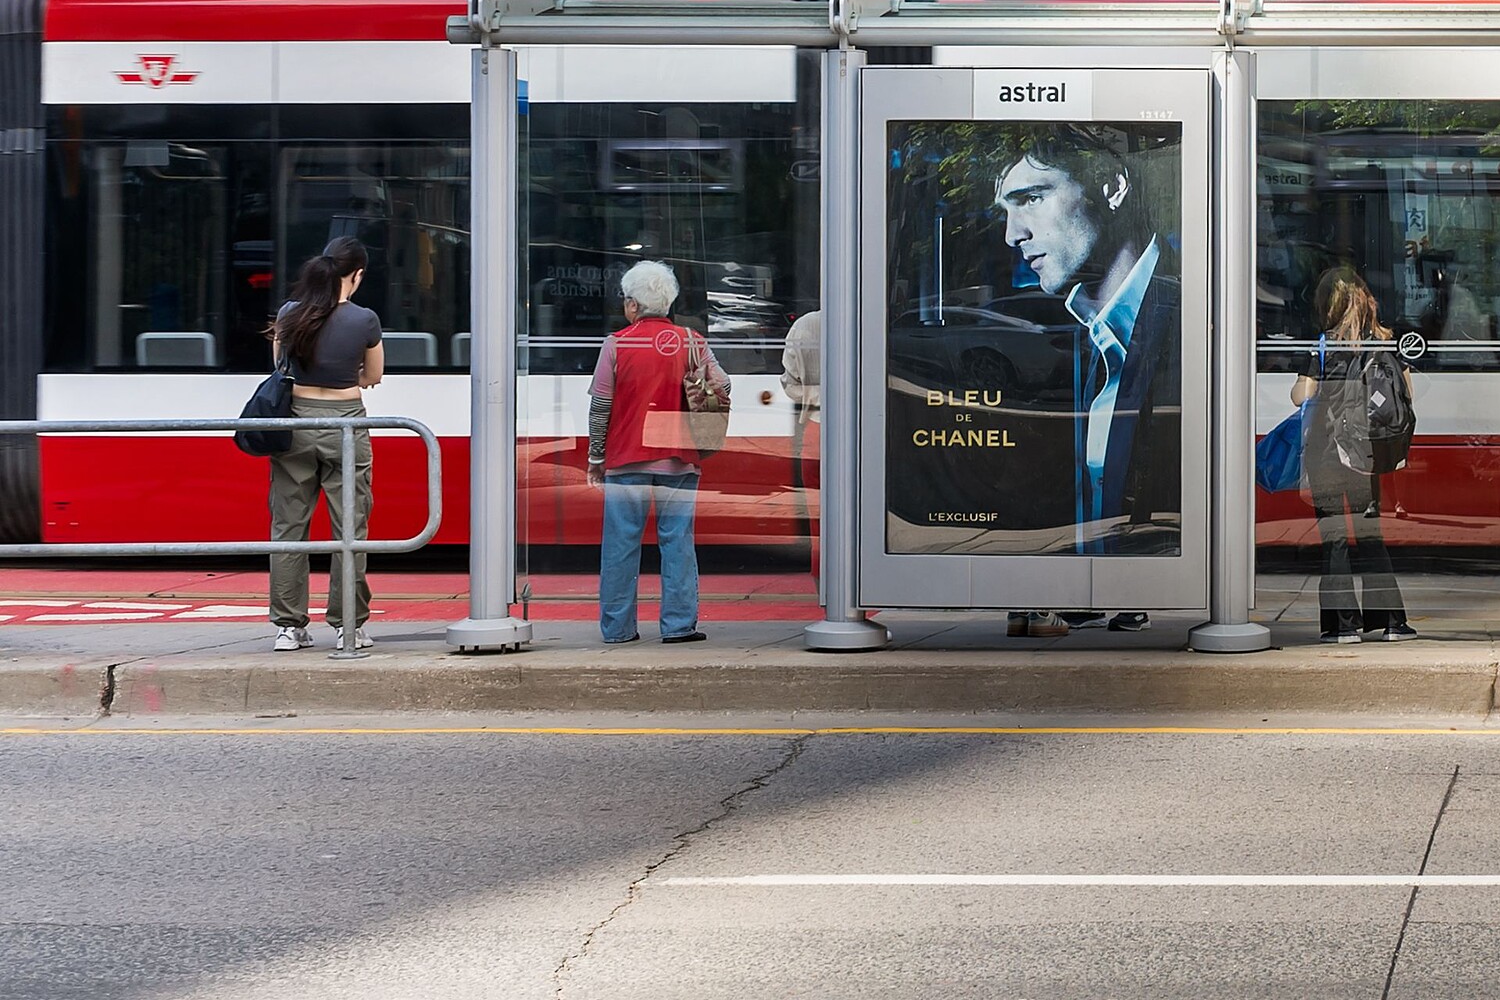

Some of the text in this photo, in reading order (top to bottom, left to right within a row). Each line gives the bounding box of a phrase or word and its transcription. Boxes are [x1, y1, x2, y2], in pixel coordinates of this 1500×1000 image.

[999, 82, 1066, 103] astral
[1139, 110, 1173, 119] 13147
[926, 390, 1003, 406] BLEU
[955, 413, 973, 422] DE
[912, 429, 1016, 447] CHANEL
[928, 512, 998, 523] L'EXCLUSIF
